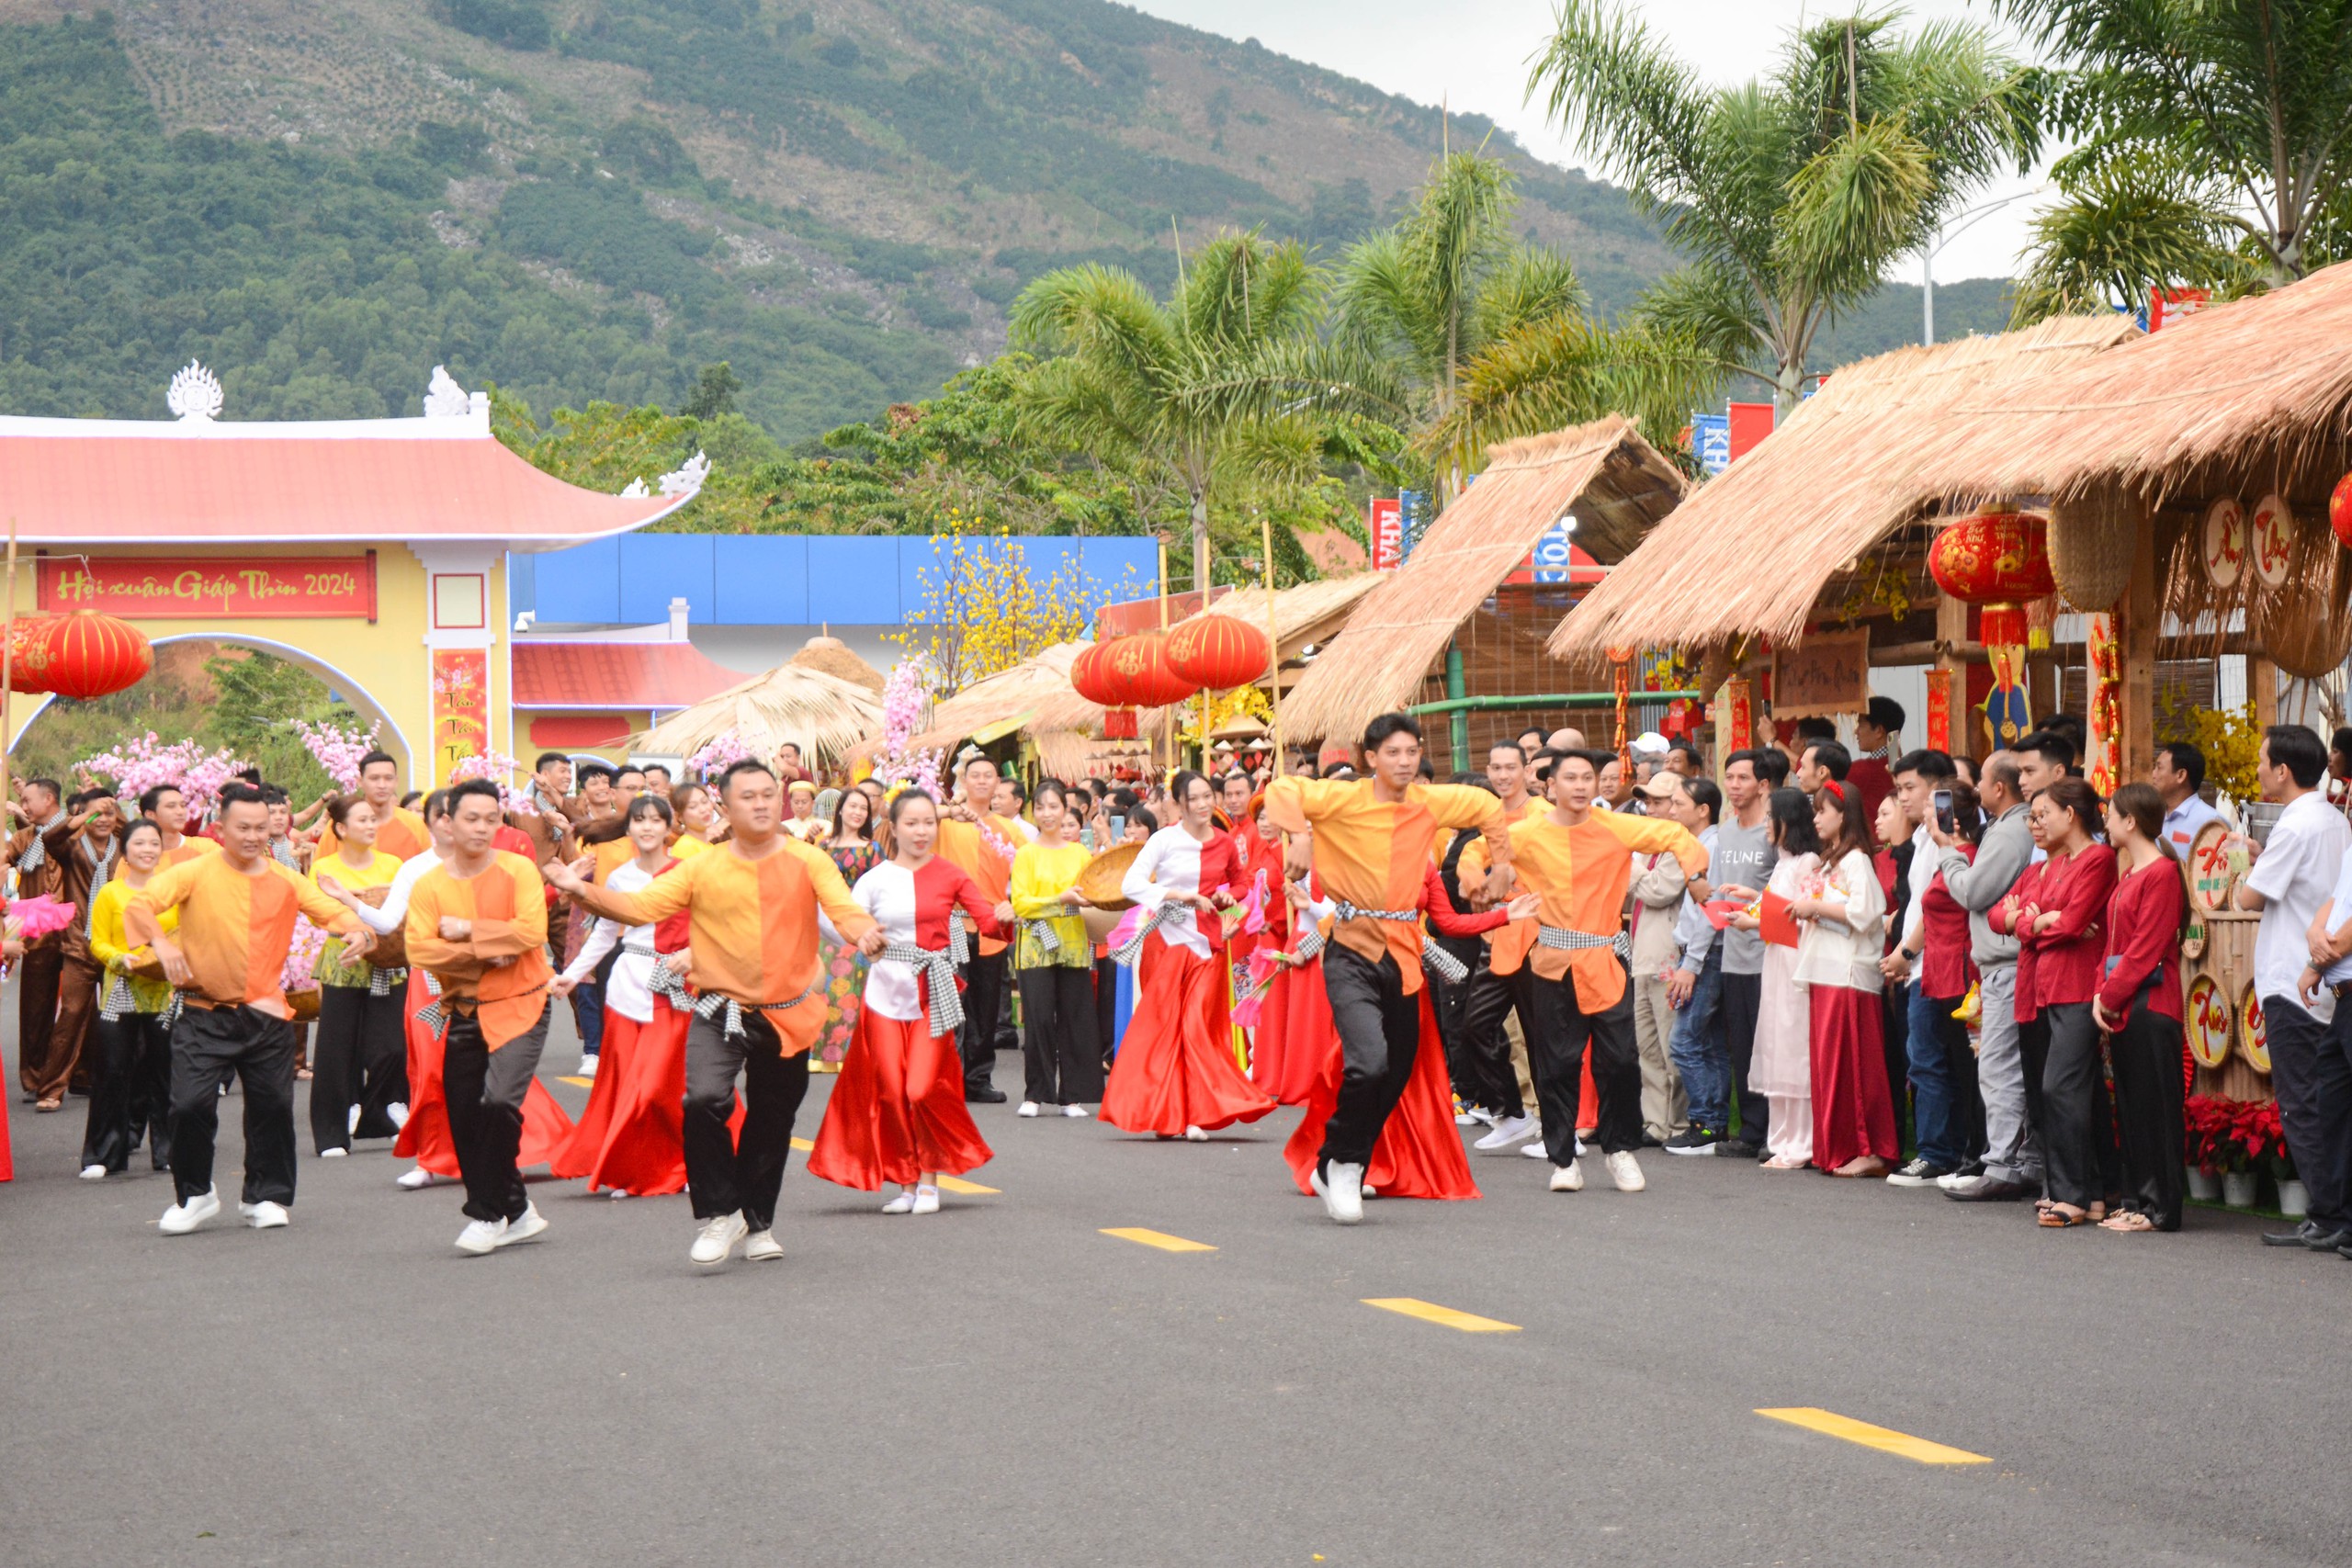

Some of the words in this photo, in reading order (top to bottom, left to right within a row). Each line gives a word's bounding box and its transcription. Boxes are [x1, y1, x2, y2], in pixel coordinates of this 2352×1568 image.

[57, 570, 105, 602] Hội
[108, 576, 173, 598] xuân
[173, 570, 239, 612] Giáp
[239, 570, 299, 599] Thìn
[304, 572, 356, 596] 2024
[1720, 850, 1764, 864] CELINE
